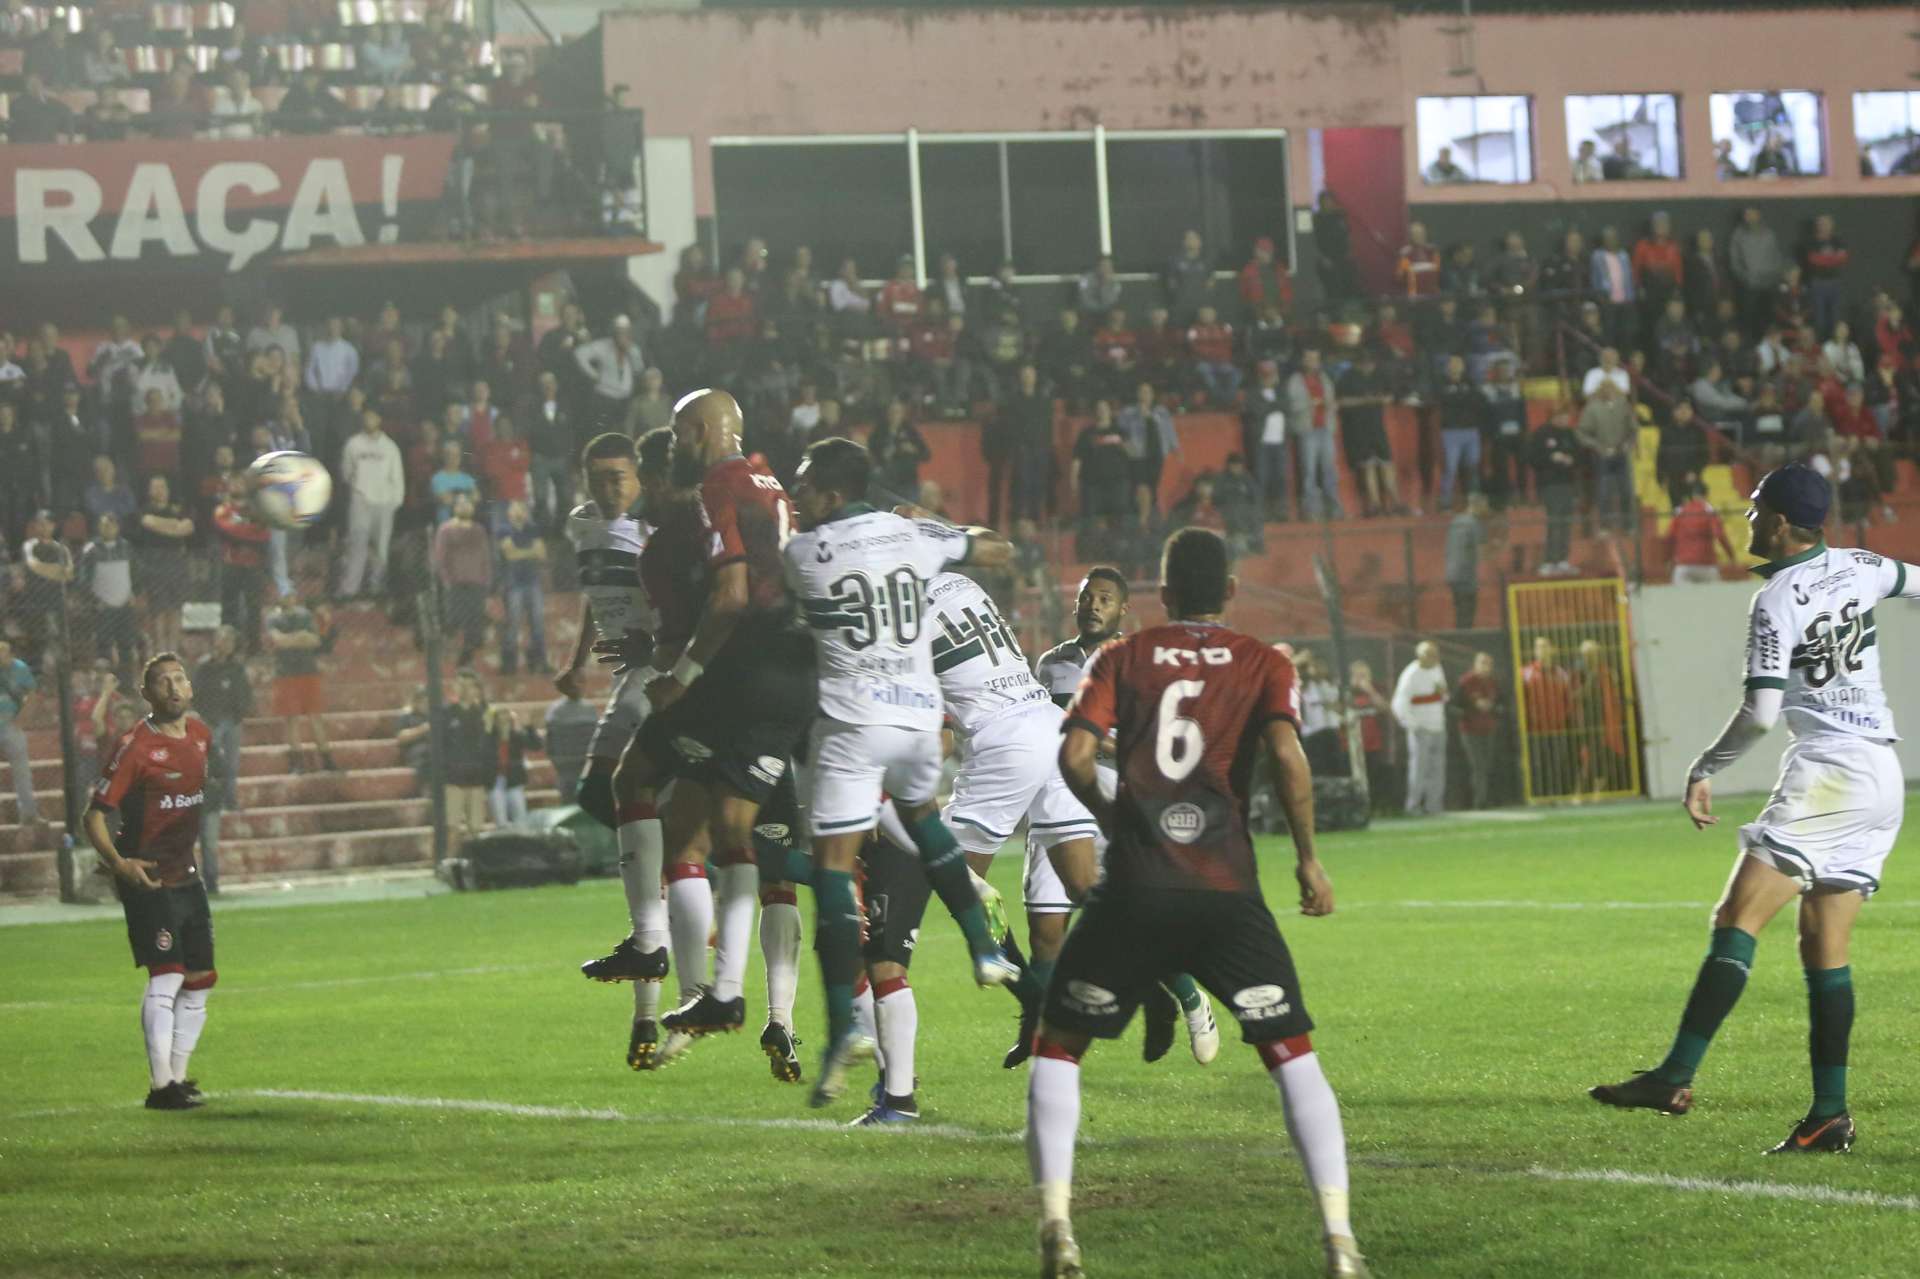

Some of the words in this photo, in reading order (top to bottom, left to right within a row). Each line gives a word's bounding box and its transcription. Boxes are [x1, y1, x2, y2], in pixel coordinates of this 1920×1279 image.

[15, 155, 404, 272] RAÇA!
[829, 563, 921, 652] 30
[1153, 646, 1233, 667] KTO
[1156, 679, 1205, 782] 6
